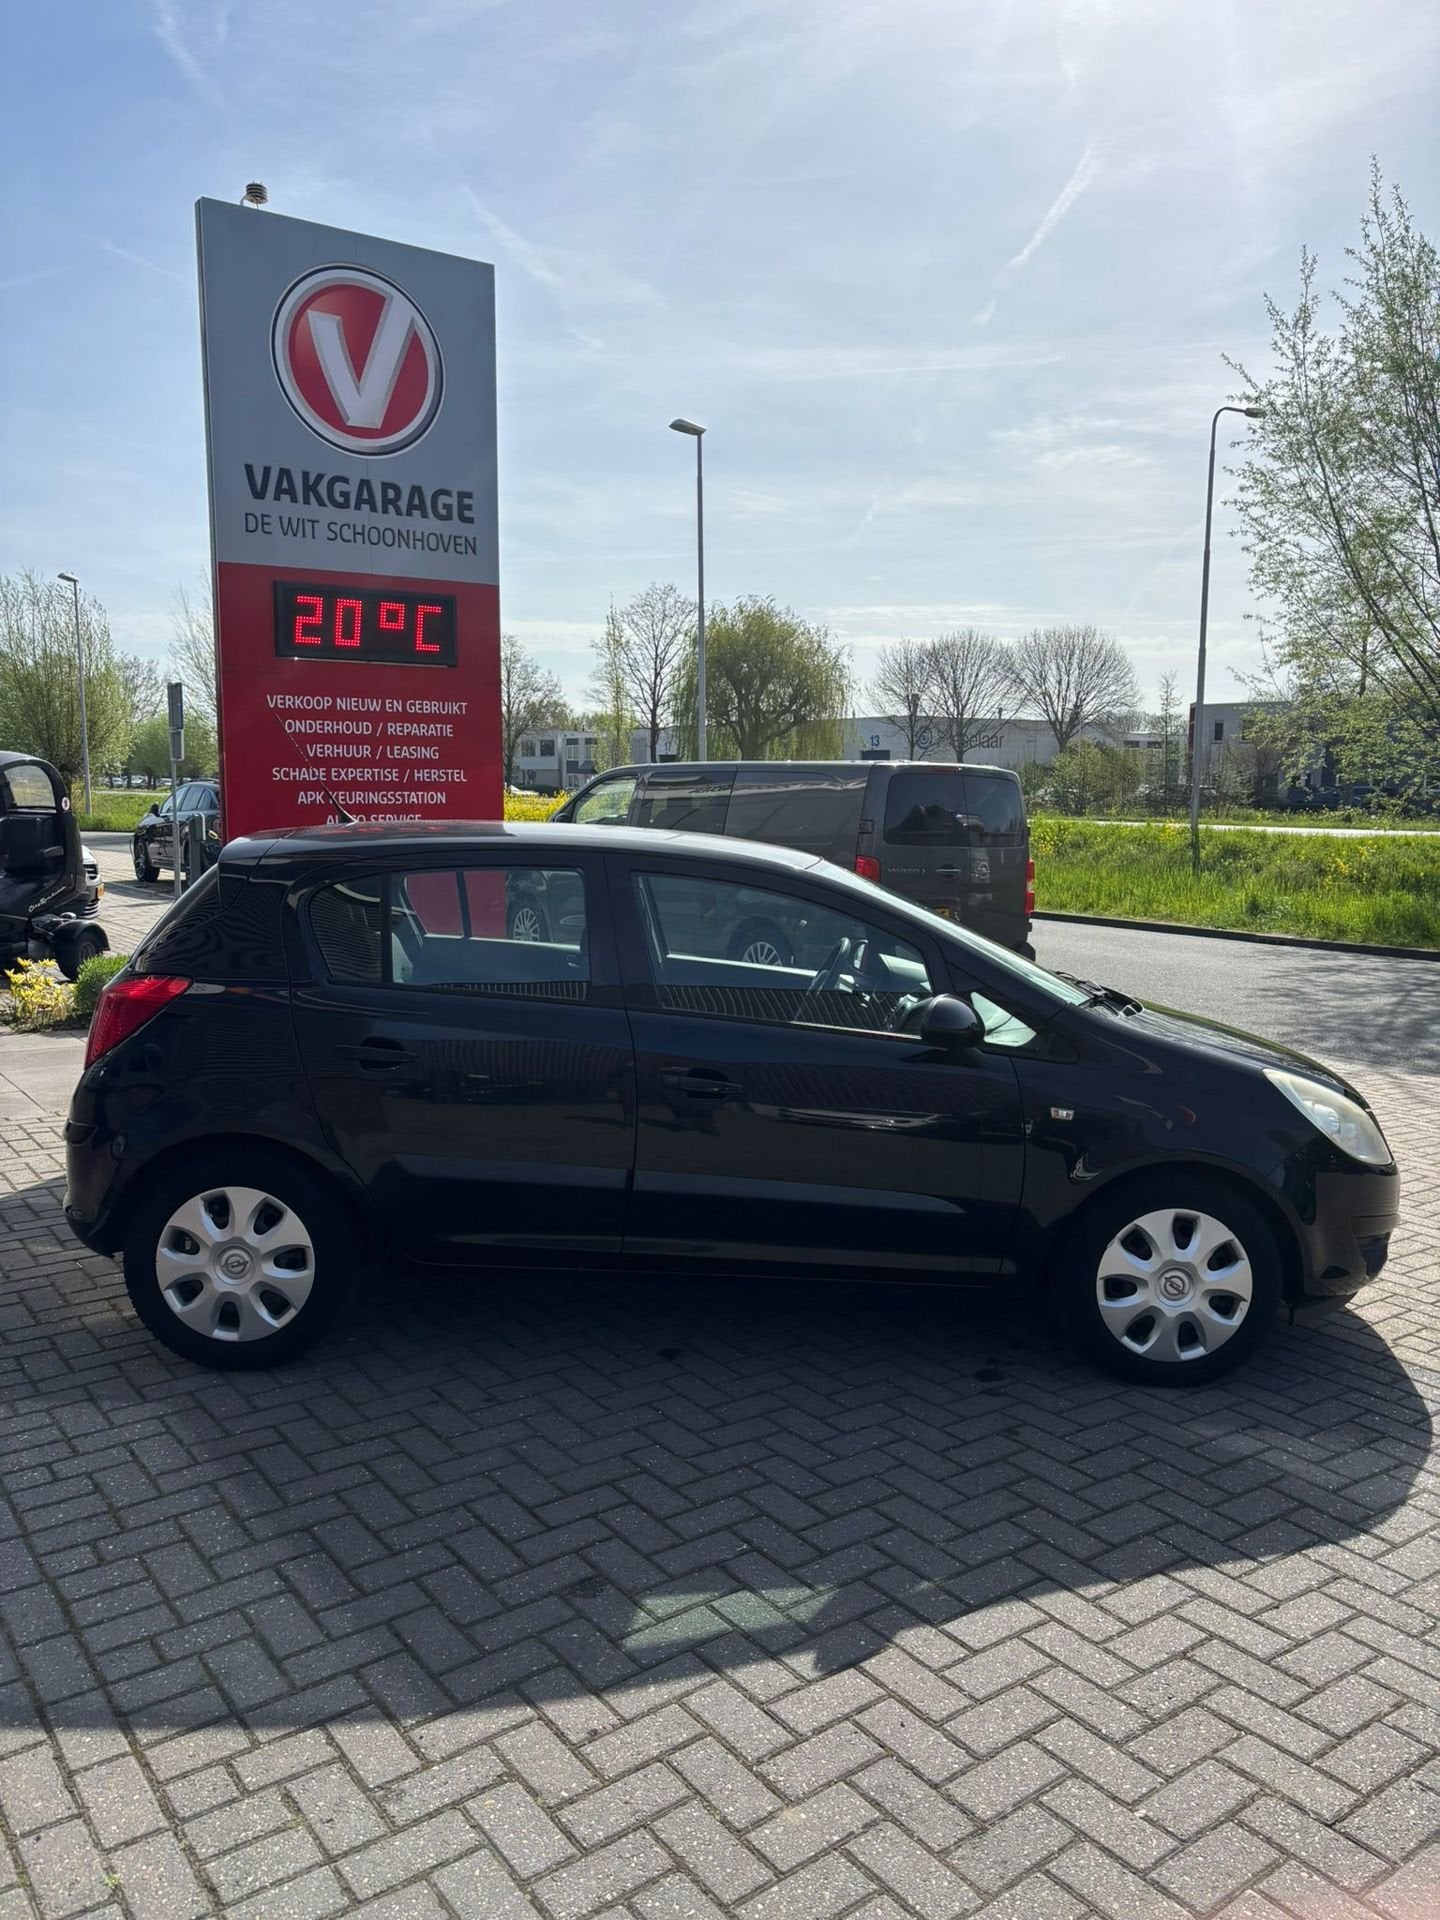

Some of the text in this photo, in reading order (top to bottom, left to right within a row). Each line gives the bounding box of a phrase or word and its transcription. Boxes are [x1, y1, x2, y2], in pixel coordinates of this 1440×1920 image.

[244, 463, 475, 524] VAKGARAGE
[244, 512, 477, 556] DE WIT SCHOONHOVEN
[266, 694, 468, 715] VERKOOP NIEUW EN GEBRUIKT
[284, 719, 454, 737] ONDERHOUD / REPARATIE
[870, 734, 880, 747] 13
[306, 744, 440, 760] VERHUUR / LEASING
[272, 767, 468, 784] SCHADE EXPERTISE / HERSTEL
[297, 791, 446, 805] APK KEURINGSSTATION
[326, 814, 367, 825] AO
